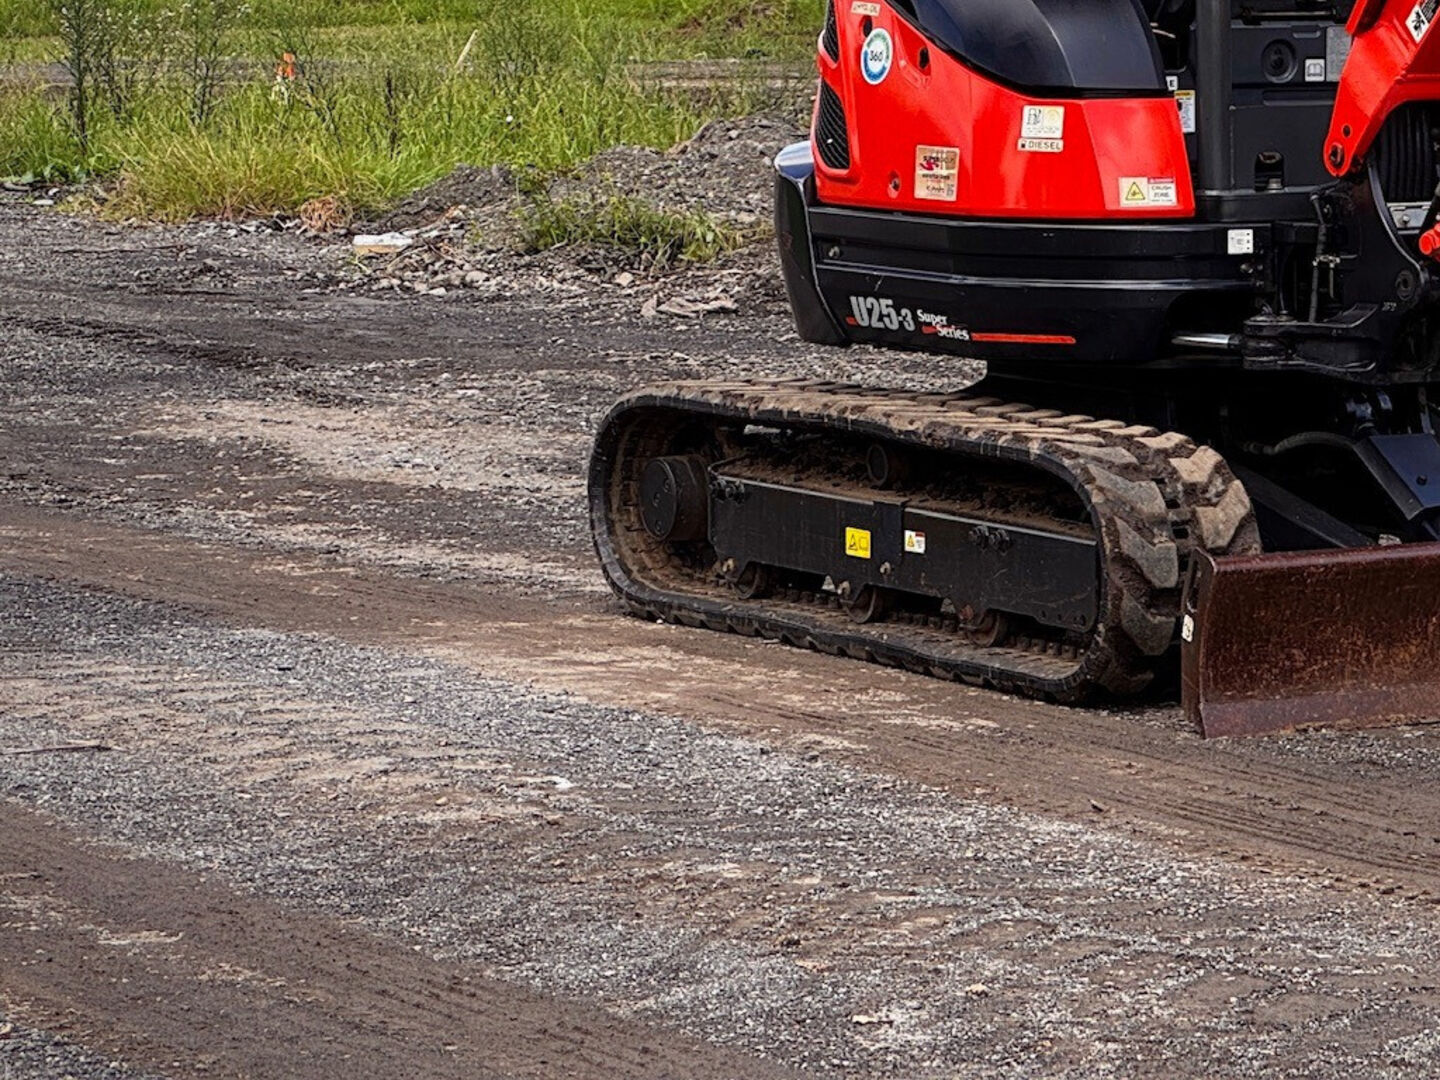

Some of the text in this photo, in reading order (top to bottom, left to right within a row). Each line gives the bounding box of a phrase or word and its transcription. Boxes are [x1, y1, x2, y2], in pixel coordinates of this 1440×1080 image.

[1028, 140, 1061, 151] DIESEL
[849, 295, 916, 332] U25-3
[916, 309, 948, 327] Super
[936, 324, 970, 340] Series
